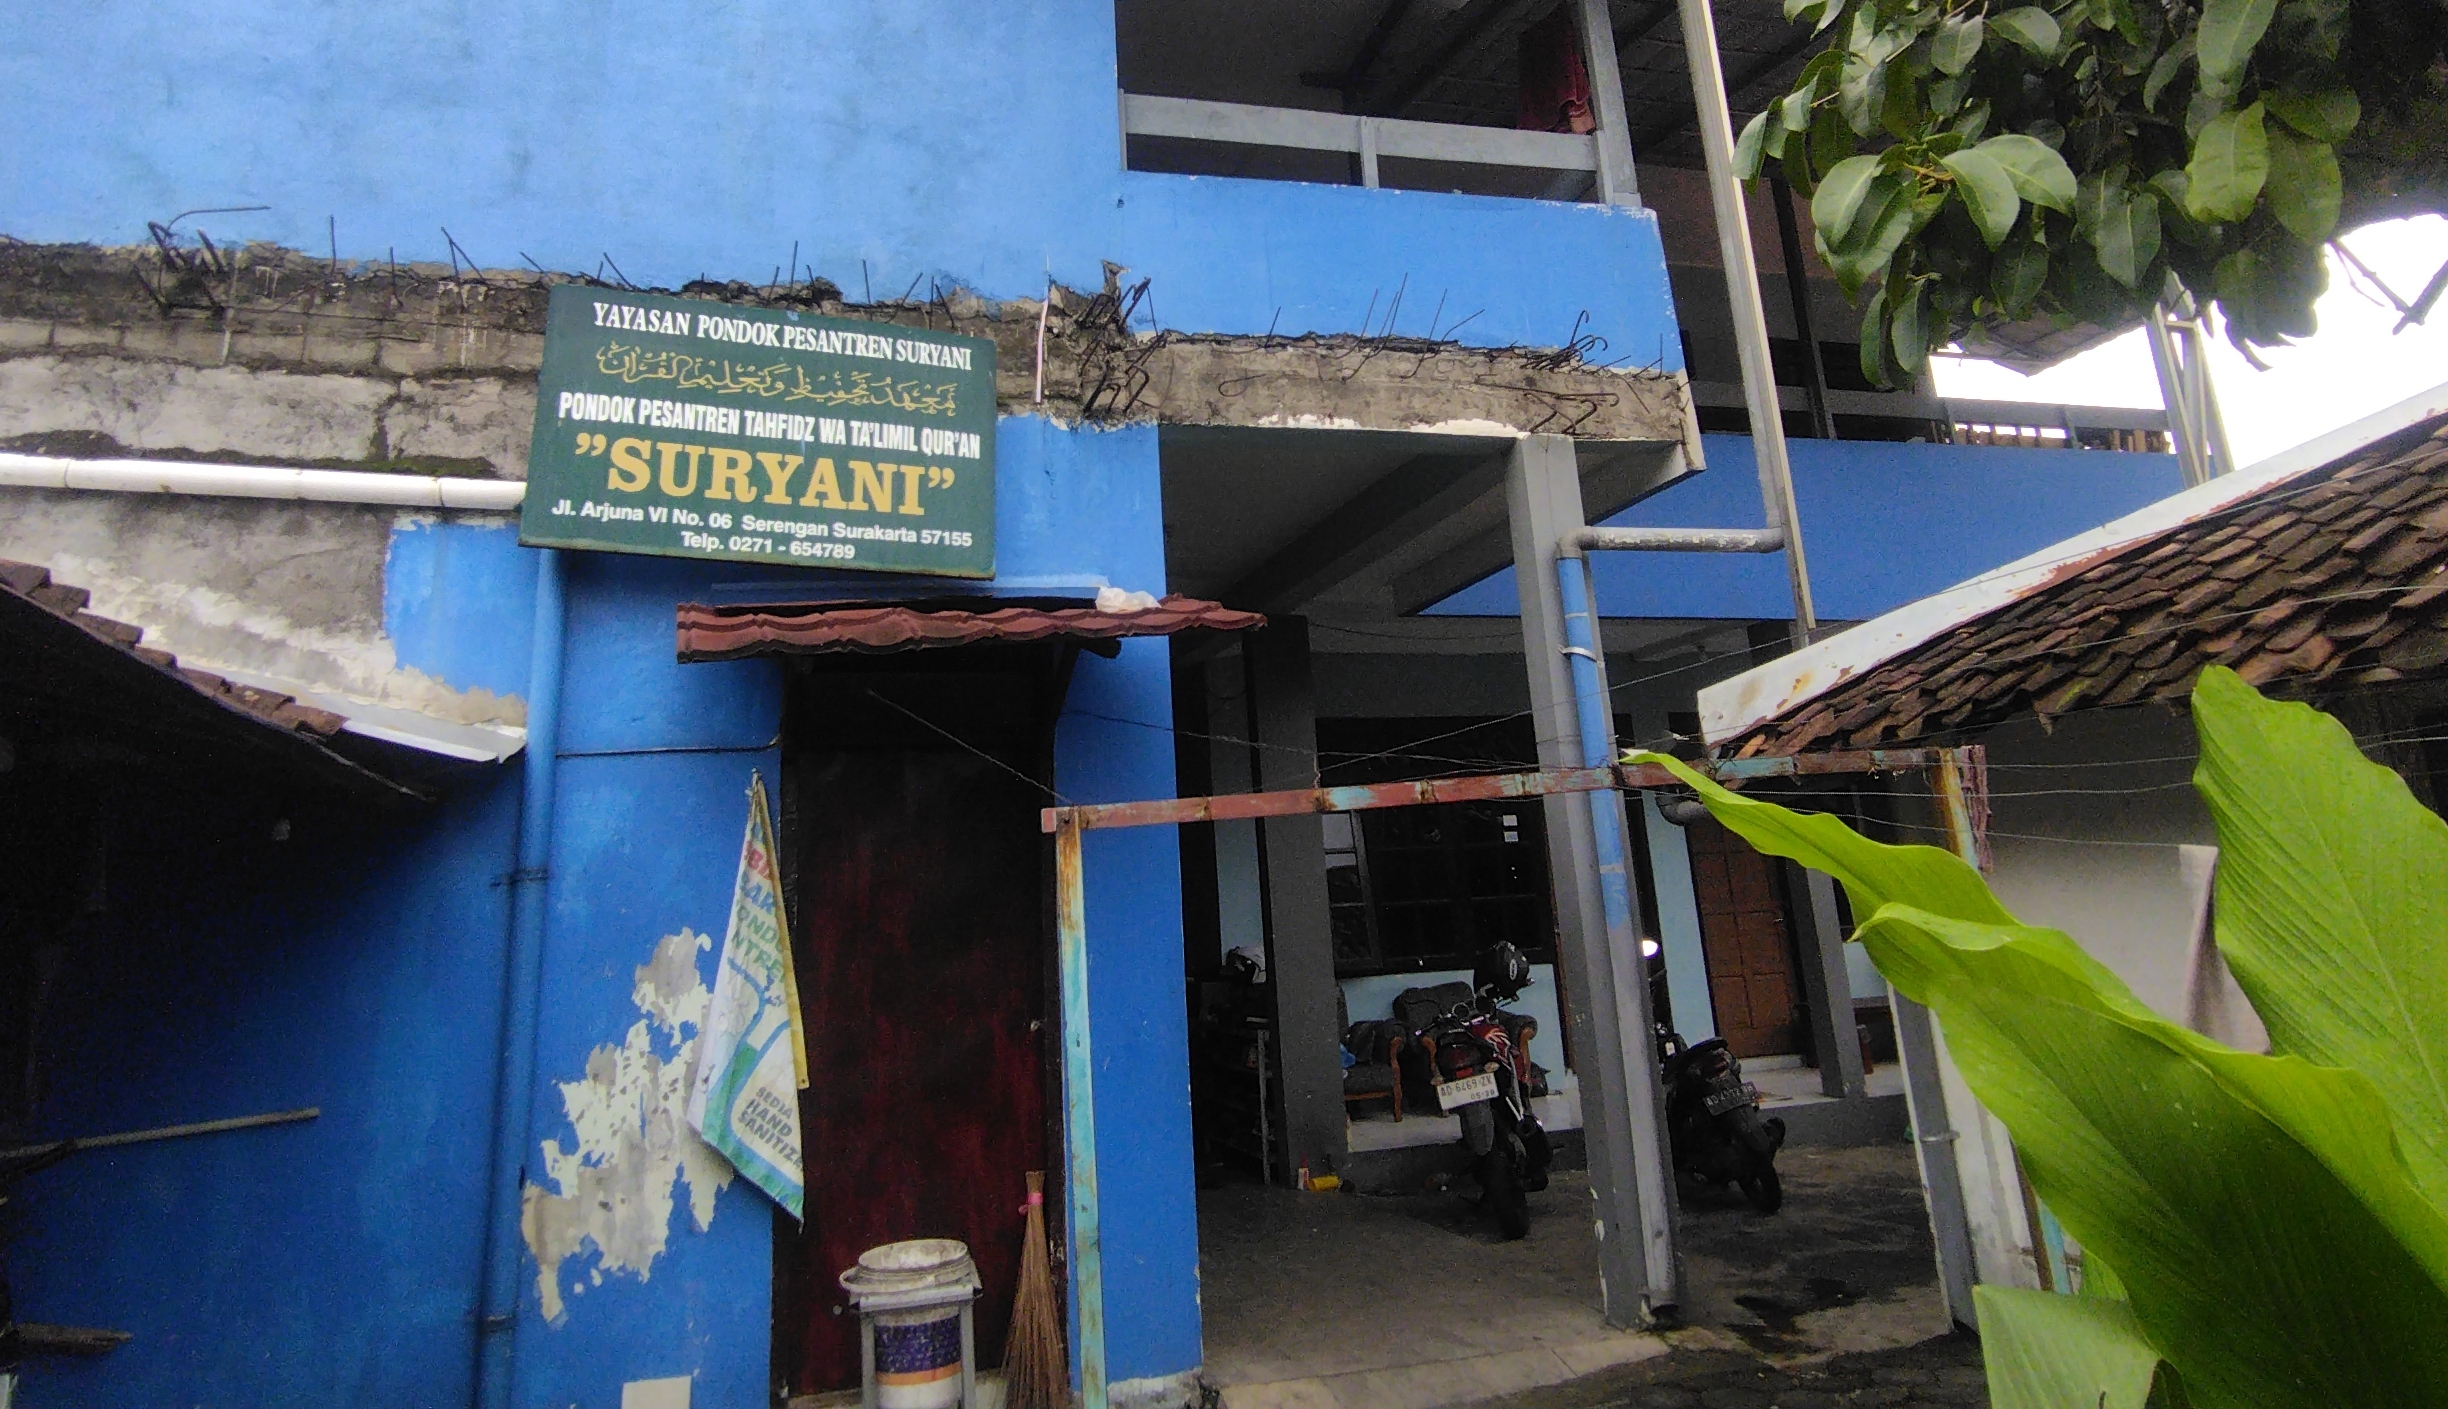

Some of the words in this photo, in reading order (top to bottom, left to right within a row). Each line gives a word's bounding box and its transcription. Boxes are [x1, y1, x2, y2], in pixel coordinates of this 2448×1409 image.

[593, 302, 691, 336] YAYASAN
[696, 314, 780, 347] PONDOK
[782, 325, 894, 360] PESANTREN
[895, 339, 972, 370] SURYANI
[558, 391, 636, 424] PONDOK
[638, 398, 740, 435] PESANTREN
[744, 410, 816, 442] TAHFIDZ
[818, 417, 847, 445] WA
[551, 499, 577, 516] Jl.
[580, 501, 645, 523] Arjuna
[648, 506, 668, 523] VI
[672, 508, 705, 527] No.
[709, 512, 733, 530] 06
[741, 514, 828, 538] Serengan
[832, 522, 918, 544] Surakarta
[920, 530, 973, 547] 57155
[681, 531, 725, 553] Telp.
[728, 536, 773, 554] 0271
[789, 541, 856, 559] 654789
[745, 1098, 793, 1137] HAND
[756, 1086, 793, 1120] SEDIA
